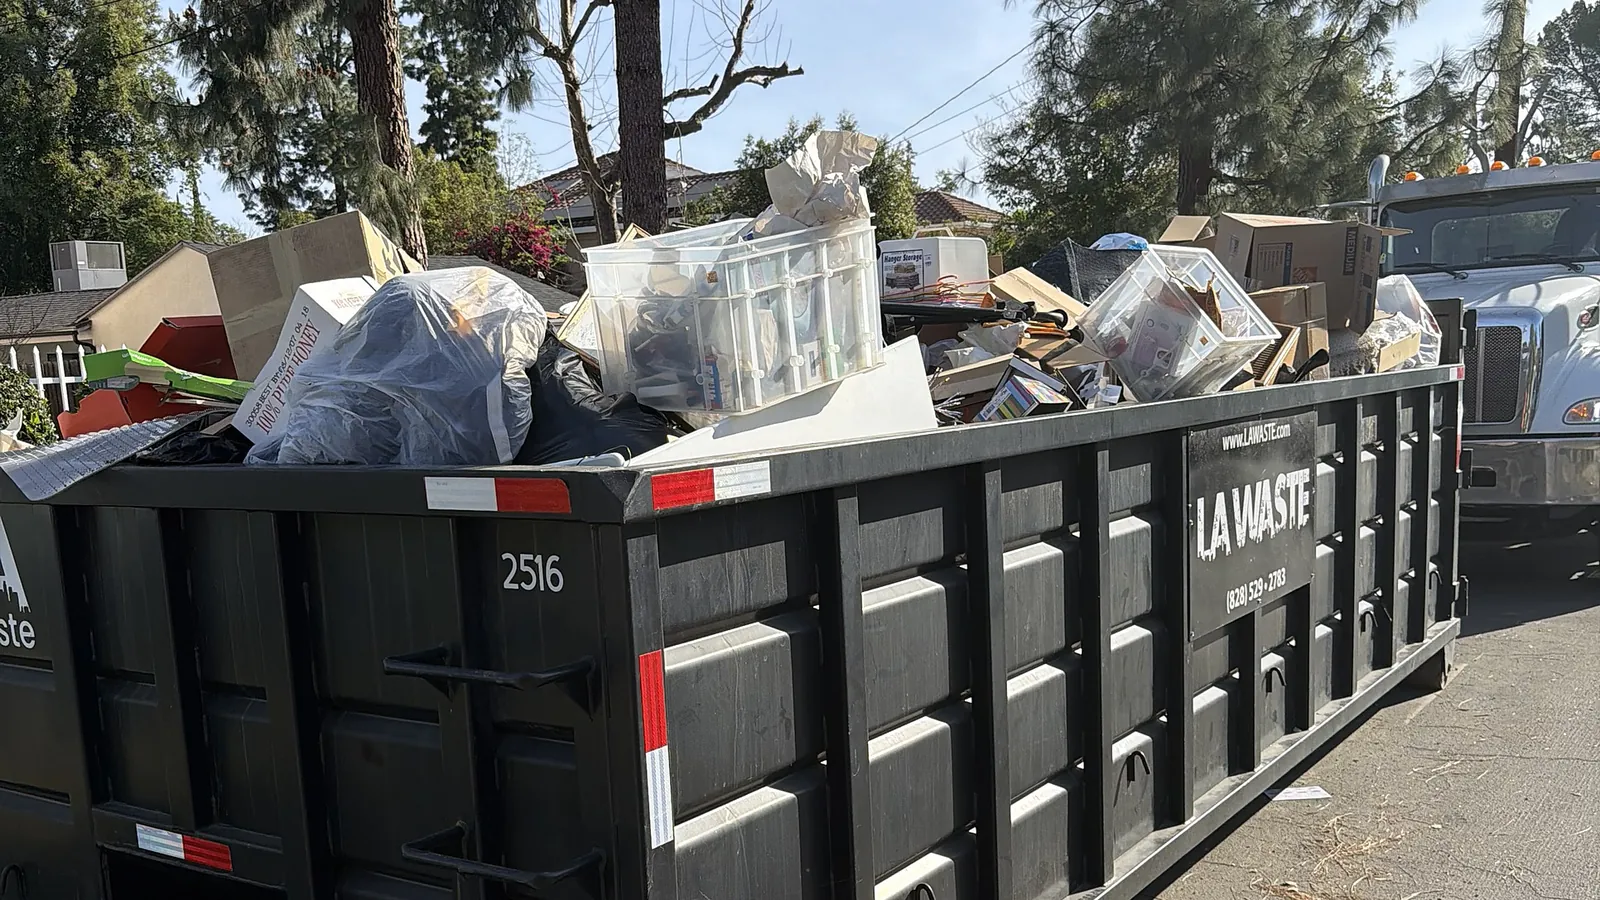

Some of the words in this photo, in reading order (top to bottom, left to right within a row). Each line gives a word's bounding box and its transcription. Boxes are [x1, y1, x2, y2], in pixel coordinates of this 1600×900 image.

[884, 255, 902, 264] Hanger
[902, 253, 923, 263] Storage
[1344, 230, 1357, 273] MEDIUM
[258, 383, 273, 404] BEST
[300, 305, 310, 318] 18
[255, 400, 281, 436] 100%
[291, 318, 321, 367] HONEY
[1222, 422, 1291, 451] www.LAWASTE.com
[1197, 491, 1232, 562] LA
[1231, 468, 1311, 549] WASTE
[501, 552, 564, 593] 2516
[1226, 583, 1248, 614] (828)
